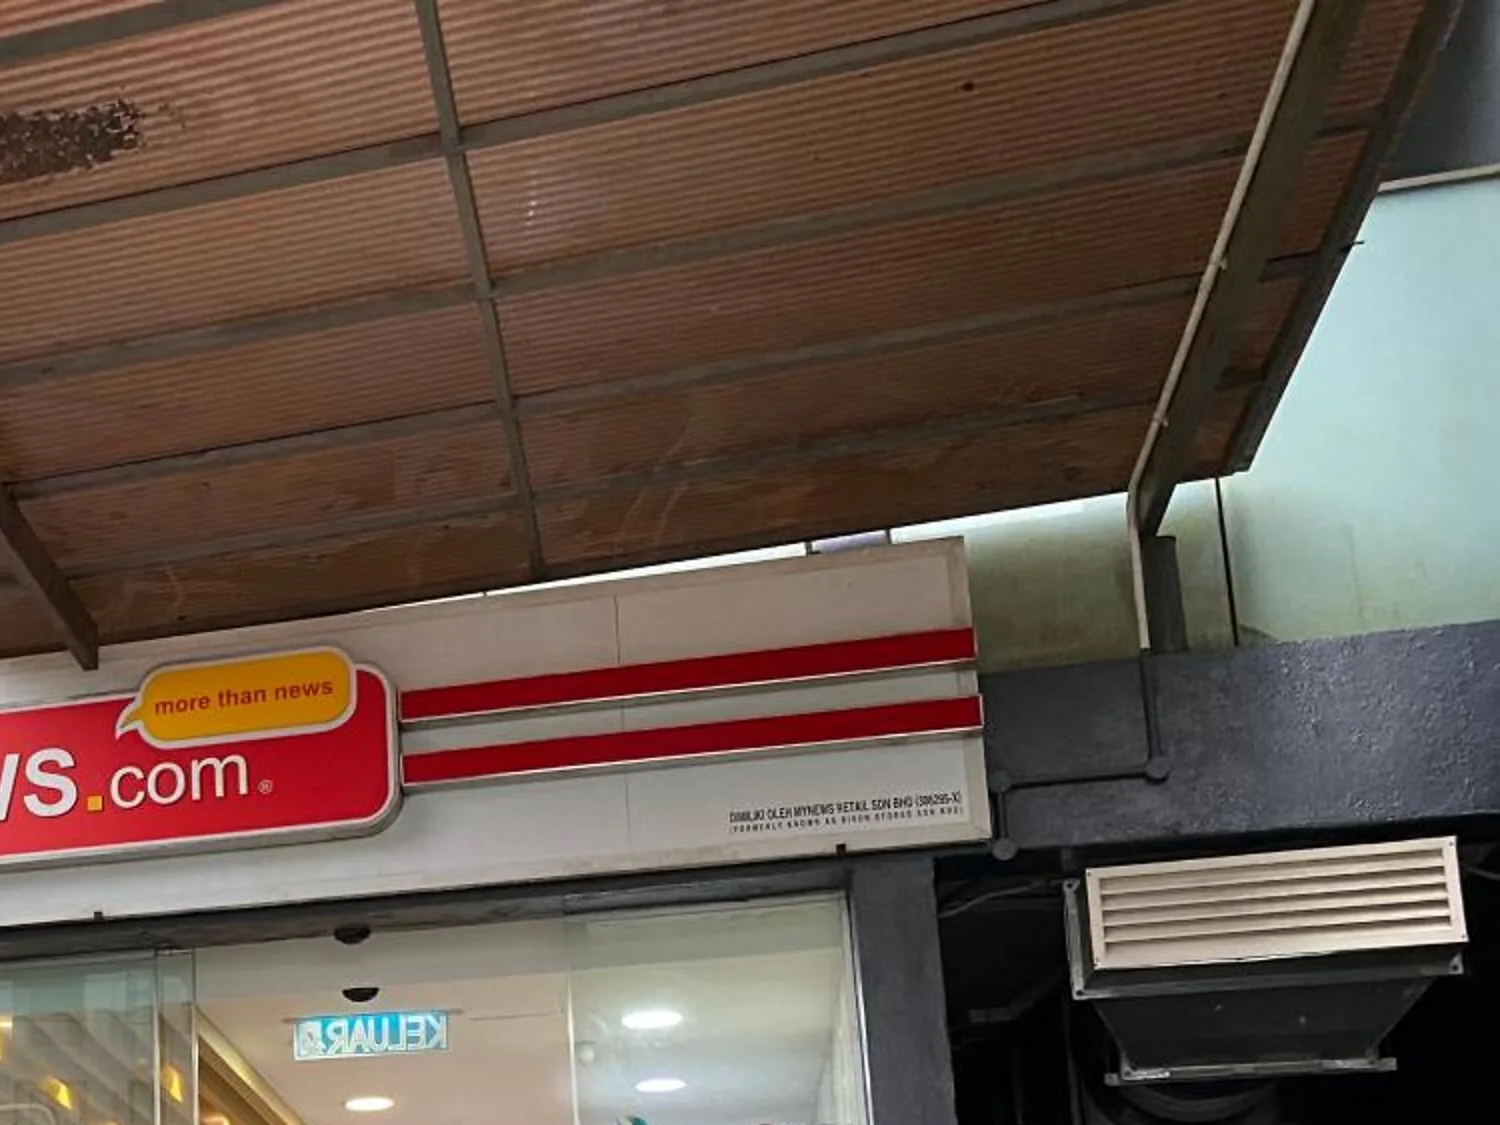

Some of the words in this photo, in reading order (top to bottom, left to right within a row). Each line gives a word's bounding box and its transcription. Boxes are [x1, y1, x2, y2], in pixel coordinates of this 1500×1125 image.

[154, 695, 211, 715] more
[217, 686, 268, 708] than
[274, 679, 334, 703] news
[871, 799, 891, 811] SDN
